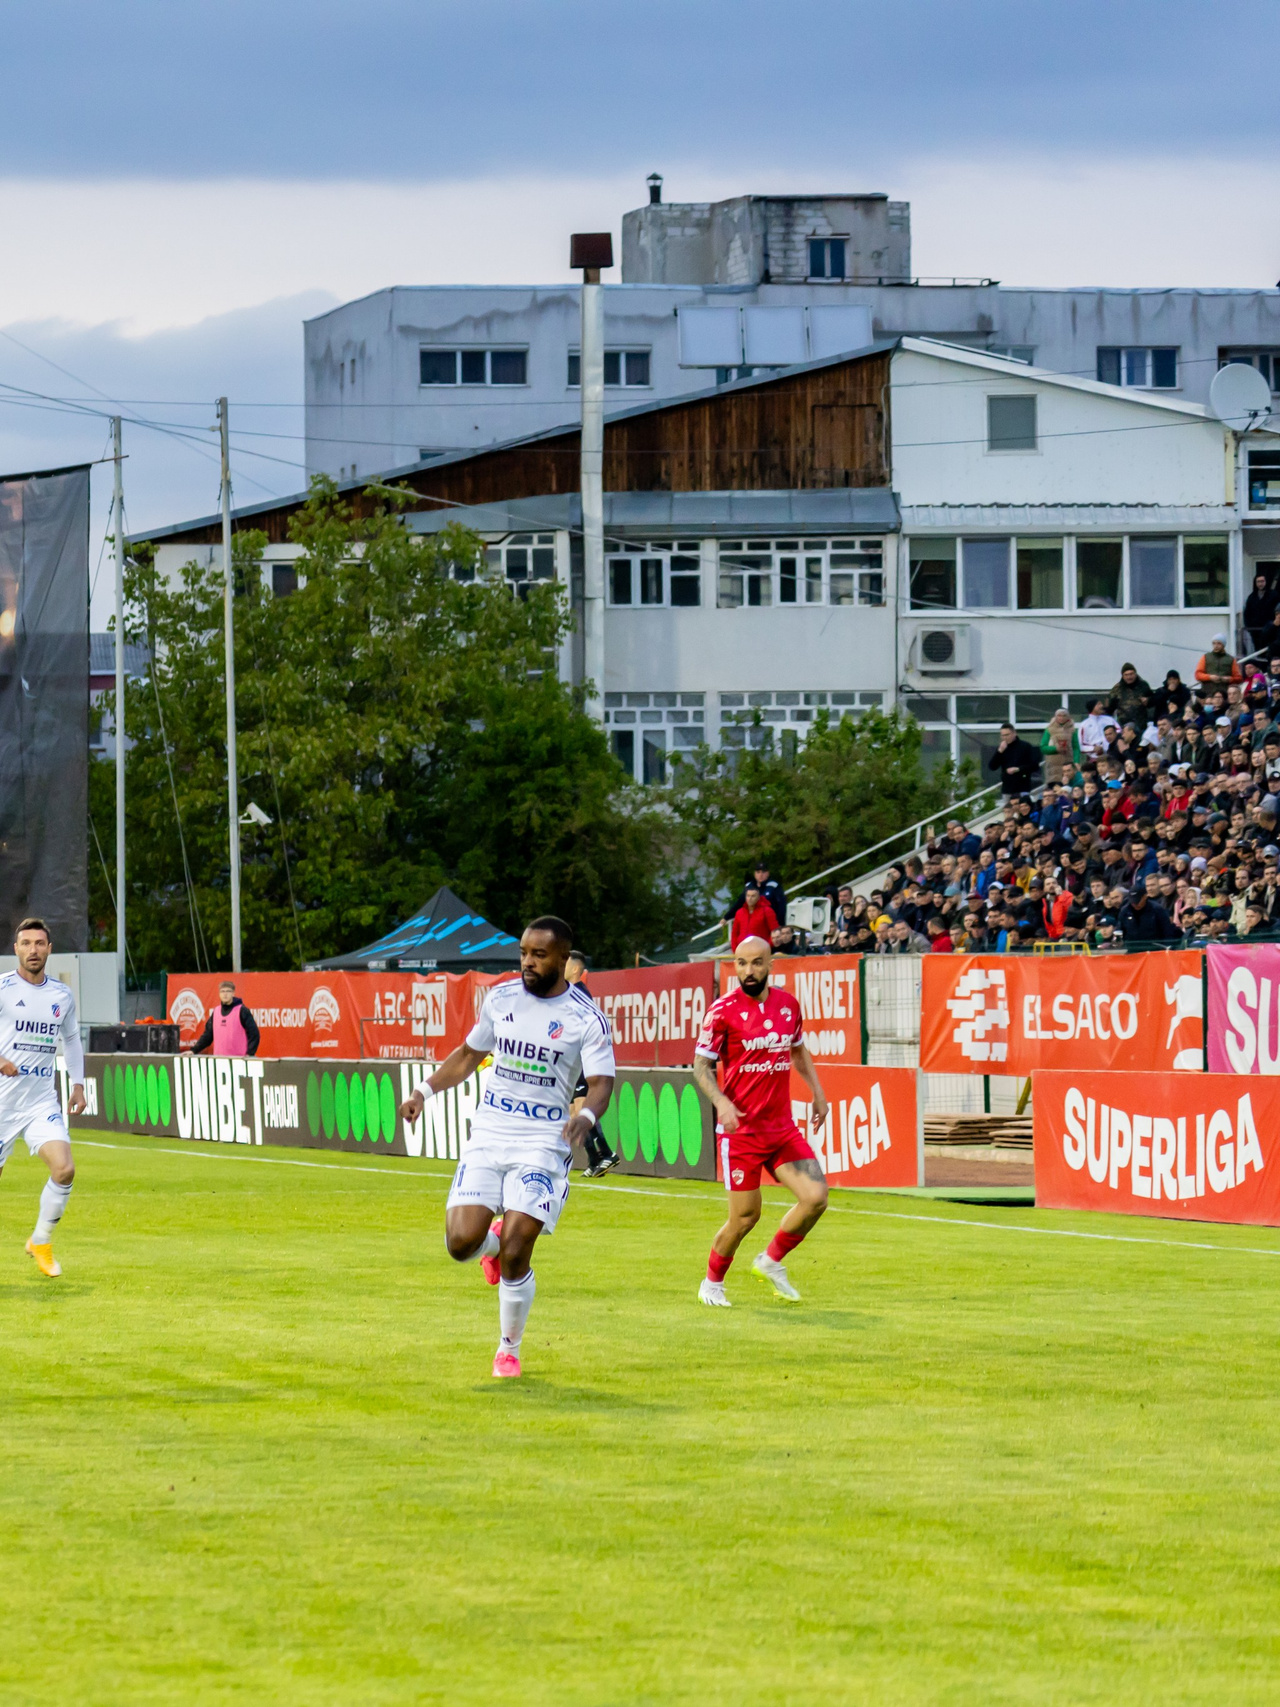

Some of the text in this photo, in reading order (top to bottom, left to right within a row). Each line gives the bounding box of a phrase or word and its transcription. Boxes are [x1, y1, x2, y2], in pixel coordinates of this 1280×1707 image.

[16, 1020, 62, 1036] UNIBET
[281, 1008, 308, 1028] GROUP
[1023, 992, 1139, 1040] ELSACO
[495, 1036, 564, 1065] UNIBET
[174, 1056, 264, 1146] UNIBET
[263, 1084, 299, 1128] PARIURI
[484, 1090, 562, 1121] ELSACO
[1064, 1087, 1264, 1201] SUPERLIGA
